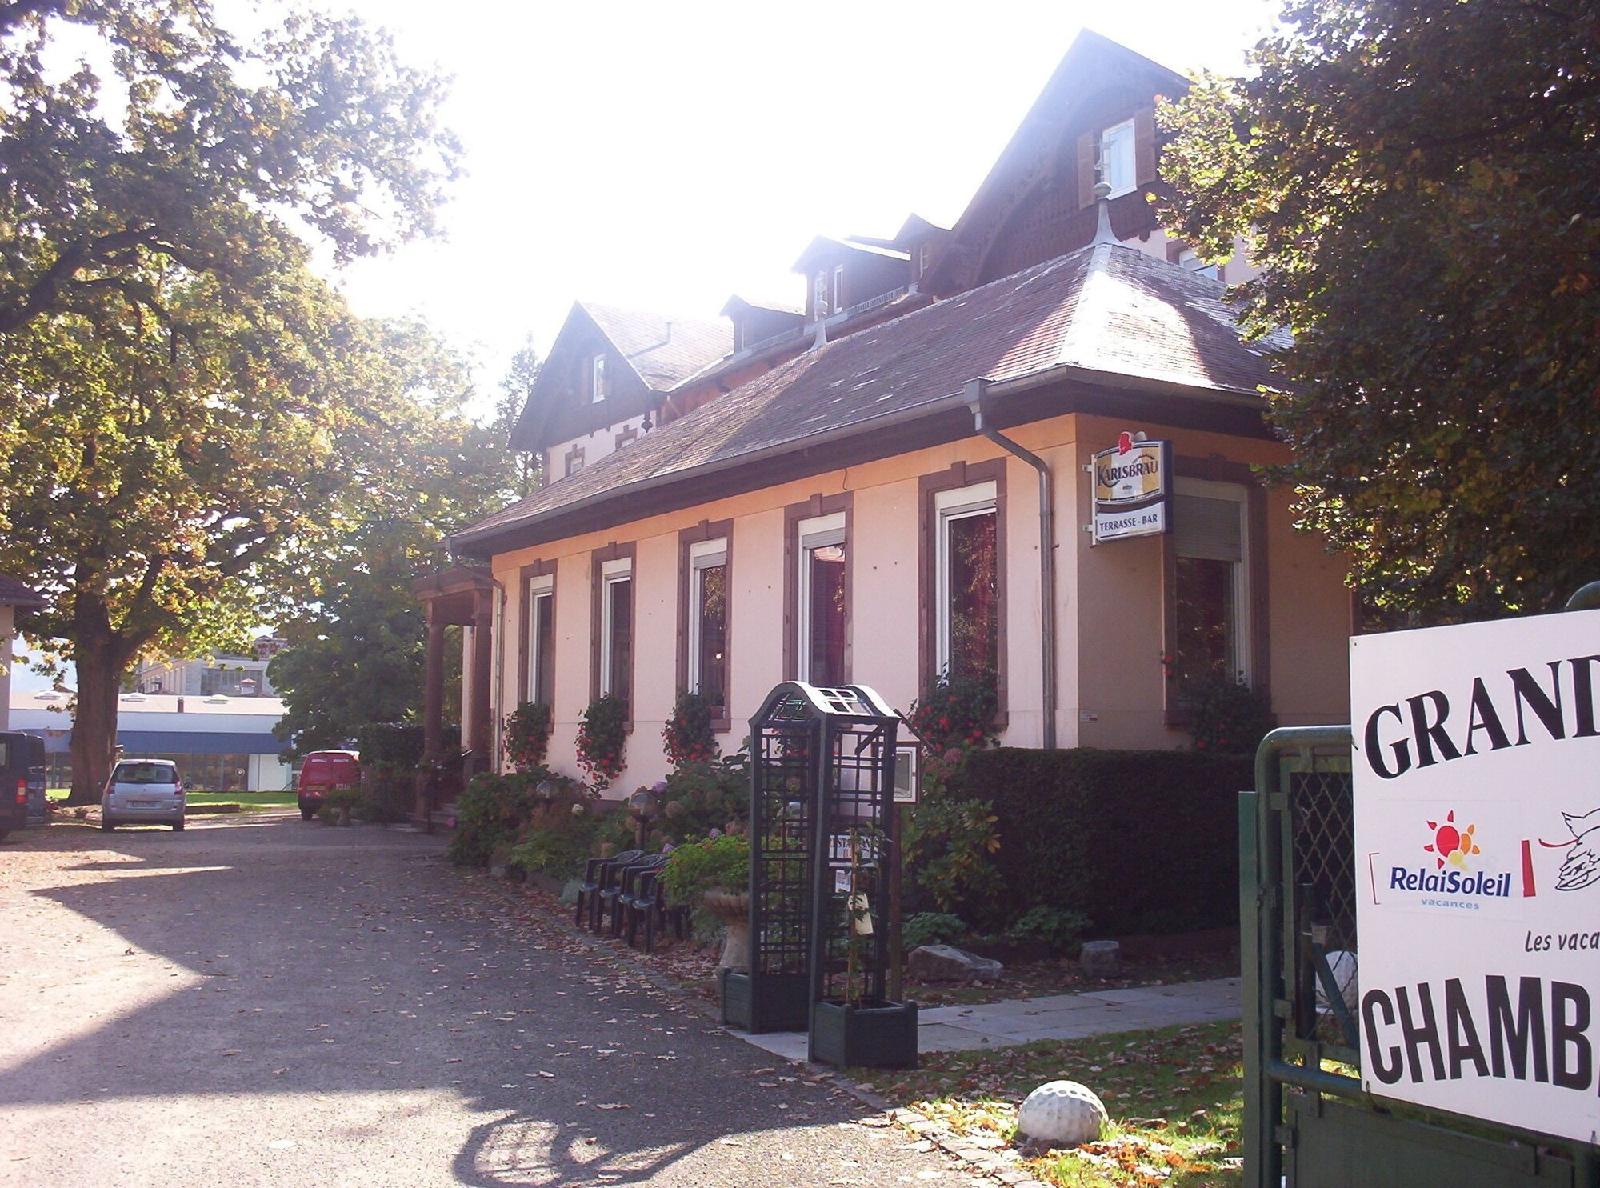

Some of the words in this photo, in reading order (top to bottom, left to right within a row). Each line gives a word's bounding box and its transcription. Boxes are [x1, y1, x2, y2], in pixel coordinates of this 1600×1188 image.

[1100, 517, 1136, 531] TERRASSE
[1141, 513, 1158, 525] BAR
[1390, 867, 1511, 898] RelaiSoleil
[1421, 898, 1480, 911] vacances
[1525, 930, 1551, 952] Les
[1558, 931, 1600, 951] vaca
[1361, 974, 1600, 1098] CHAMB
